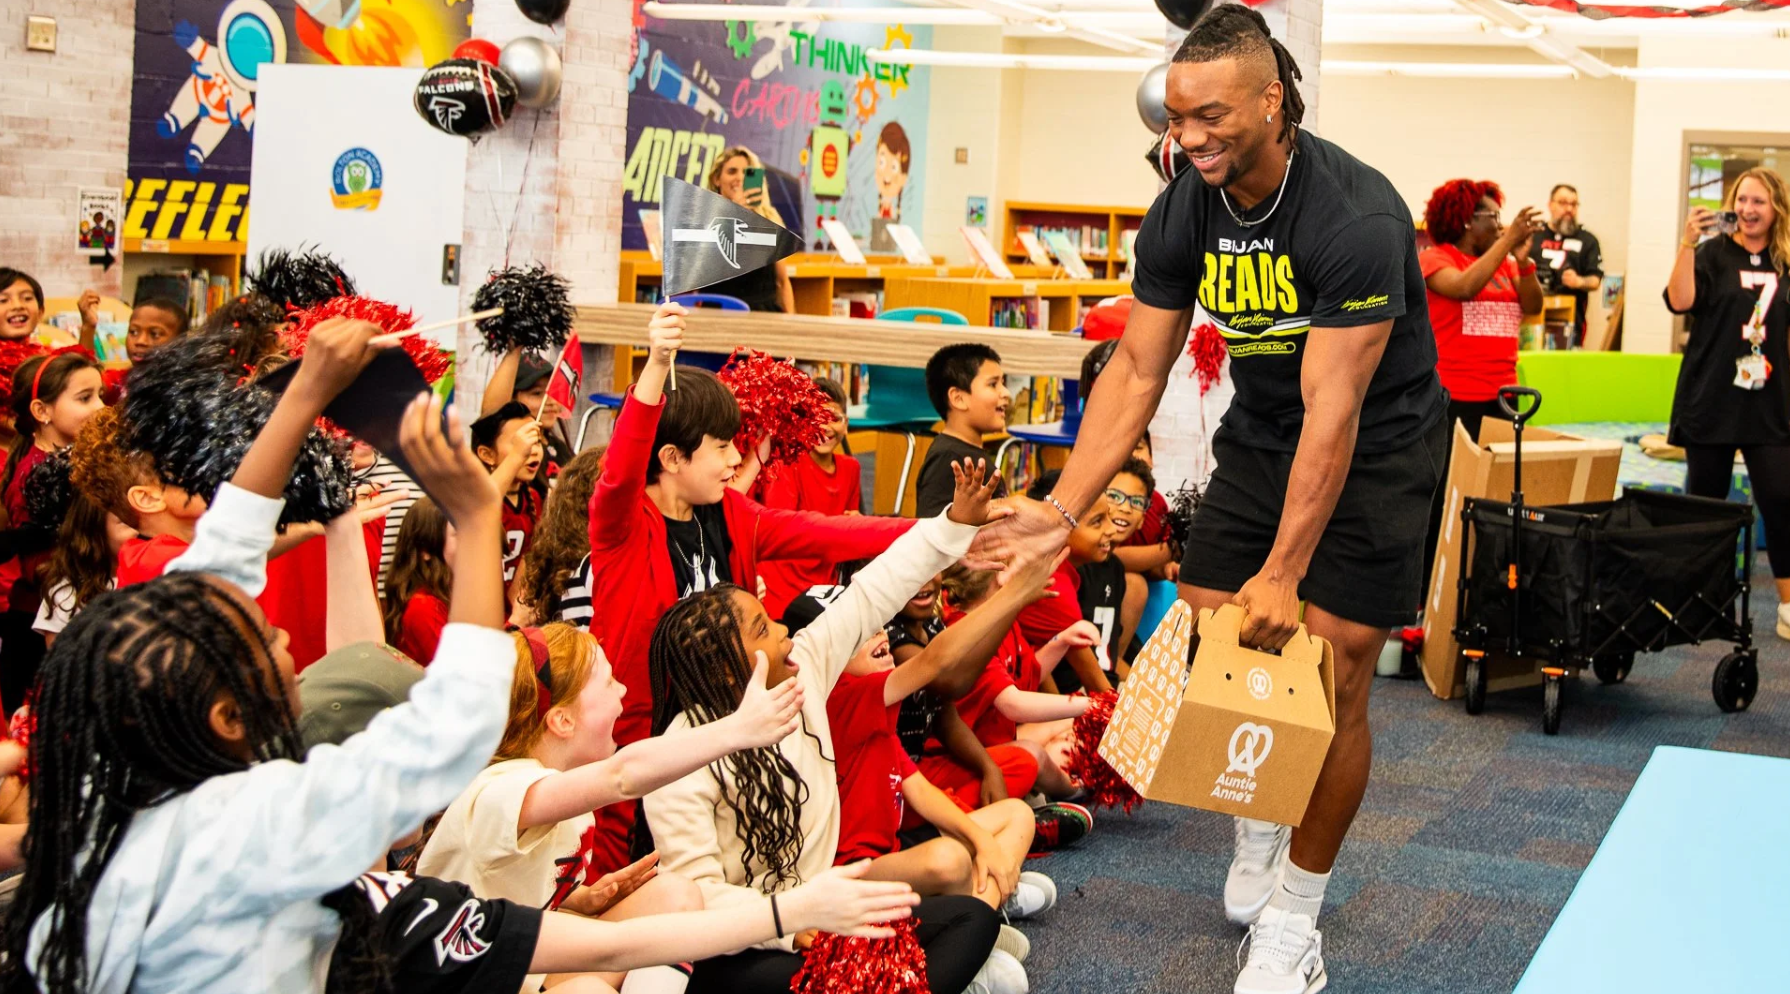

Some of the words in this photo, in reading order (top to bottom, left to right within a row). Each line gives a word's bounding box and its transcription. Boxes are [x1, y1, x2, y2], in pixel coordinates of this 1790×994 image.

[1218, 237, 1274, 253] BIJAN
[1199, 251, 1298, 313] READS
[1739, 270, 1778, 341] 7
[1093, 606, 1115, 671] 7
[1210, 785, 1254, 803] Anne's
[1215, 773, 1257, 791] Auntie
